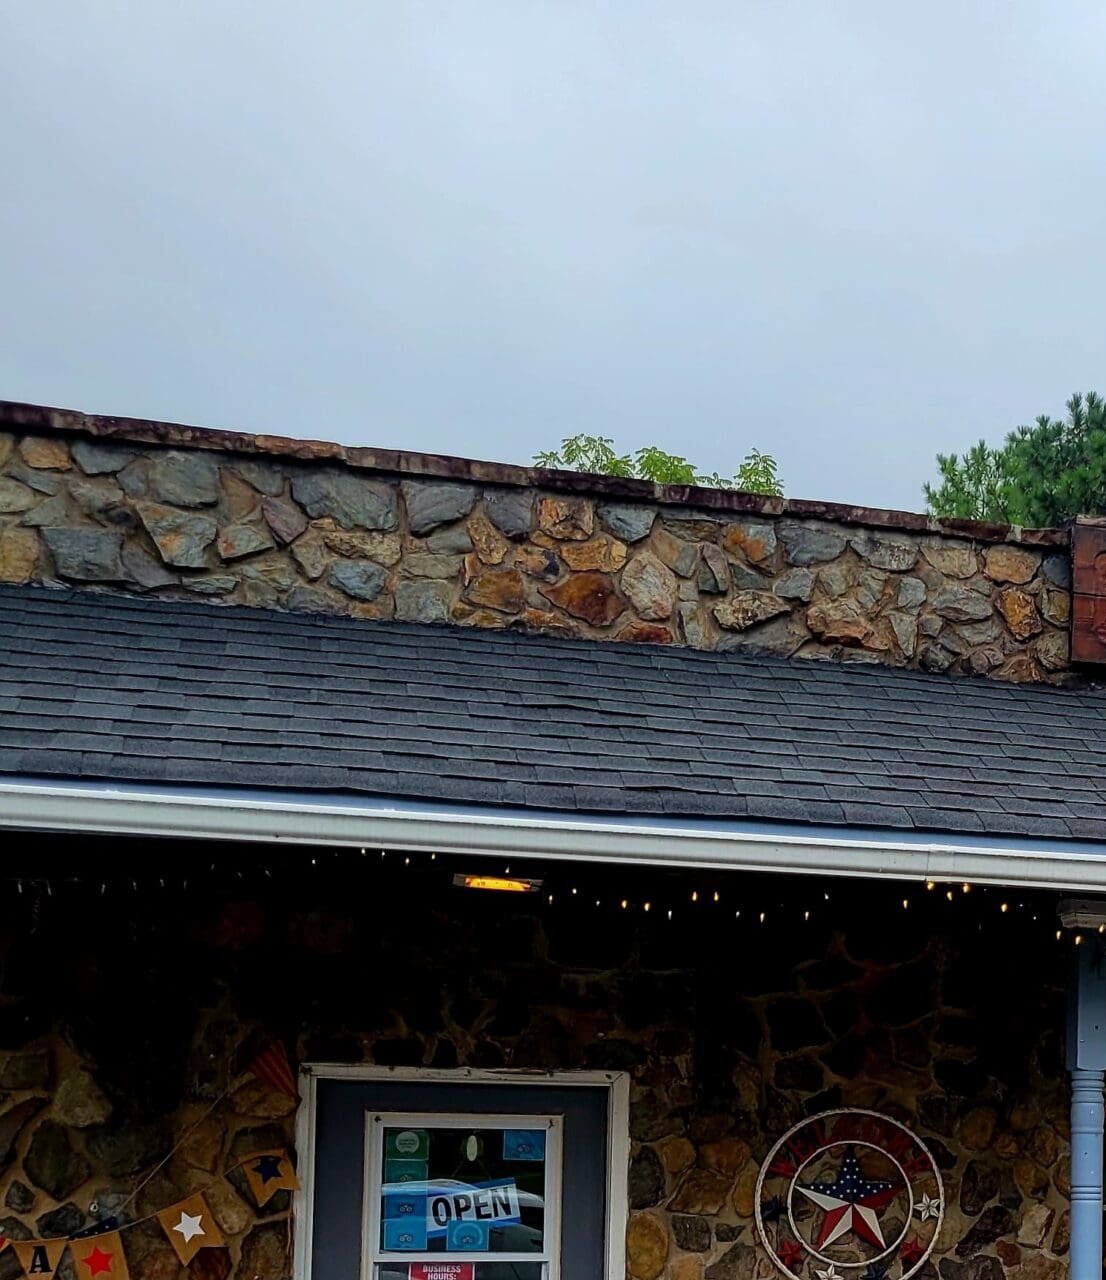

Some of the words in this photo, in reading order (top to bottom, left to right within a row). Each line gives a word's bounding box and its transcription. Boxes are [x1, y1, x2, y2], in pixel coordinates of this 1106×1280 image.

[432, 1186, 512, 1227] OPEN
[29, 1246, 53, 1273] A
[422, 1264, 461, 1272] BUSINESS
[427, 1273, 457, 1280] HOURS:
